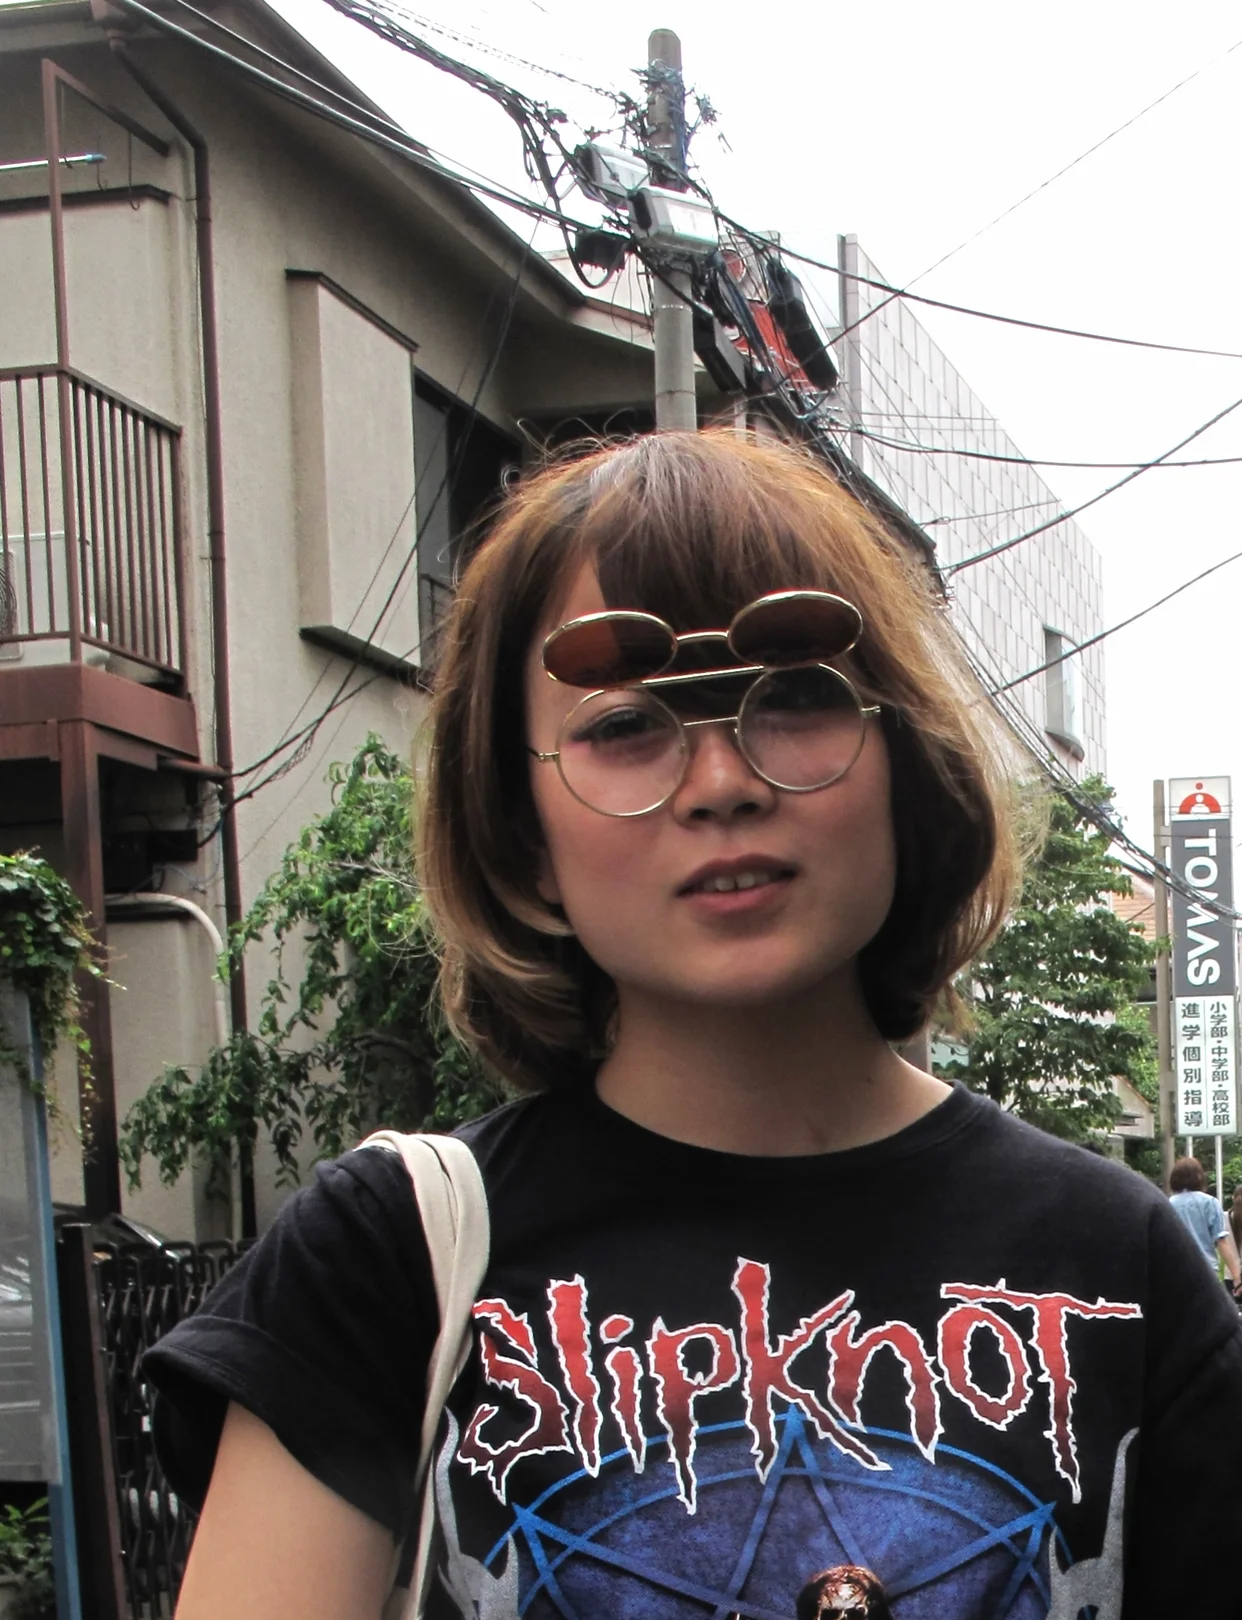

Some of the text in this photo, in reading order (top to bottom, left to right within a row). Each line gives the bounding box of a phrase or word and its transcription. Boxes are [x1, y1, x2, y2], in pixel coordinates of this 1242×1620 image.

[1184, 828, 1221, 986] TOMAS
[1181, 1002, 1203, 1127] 進学個別指導
